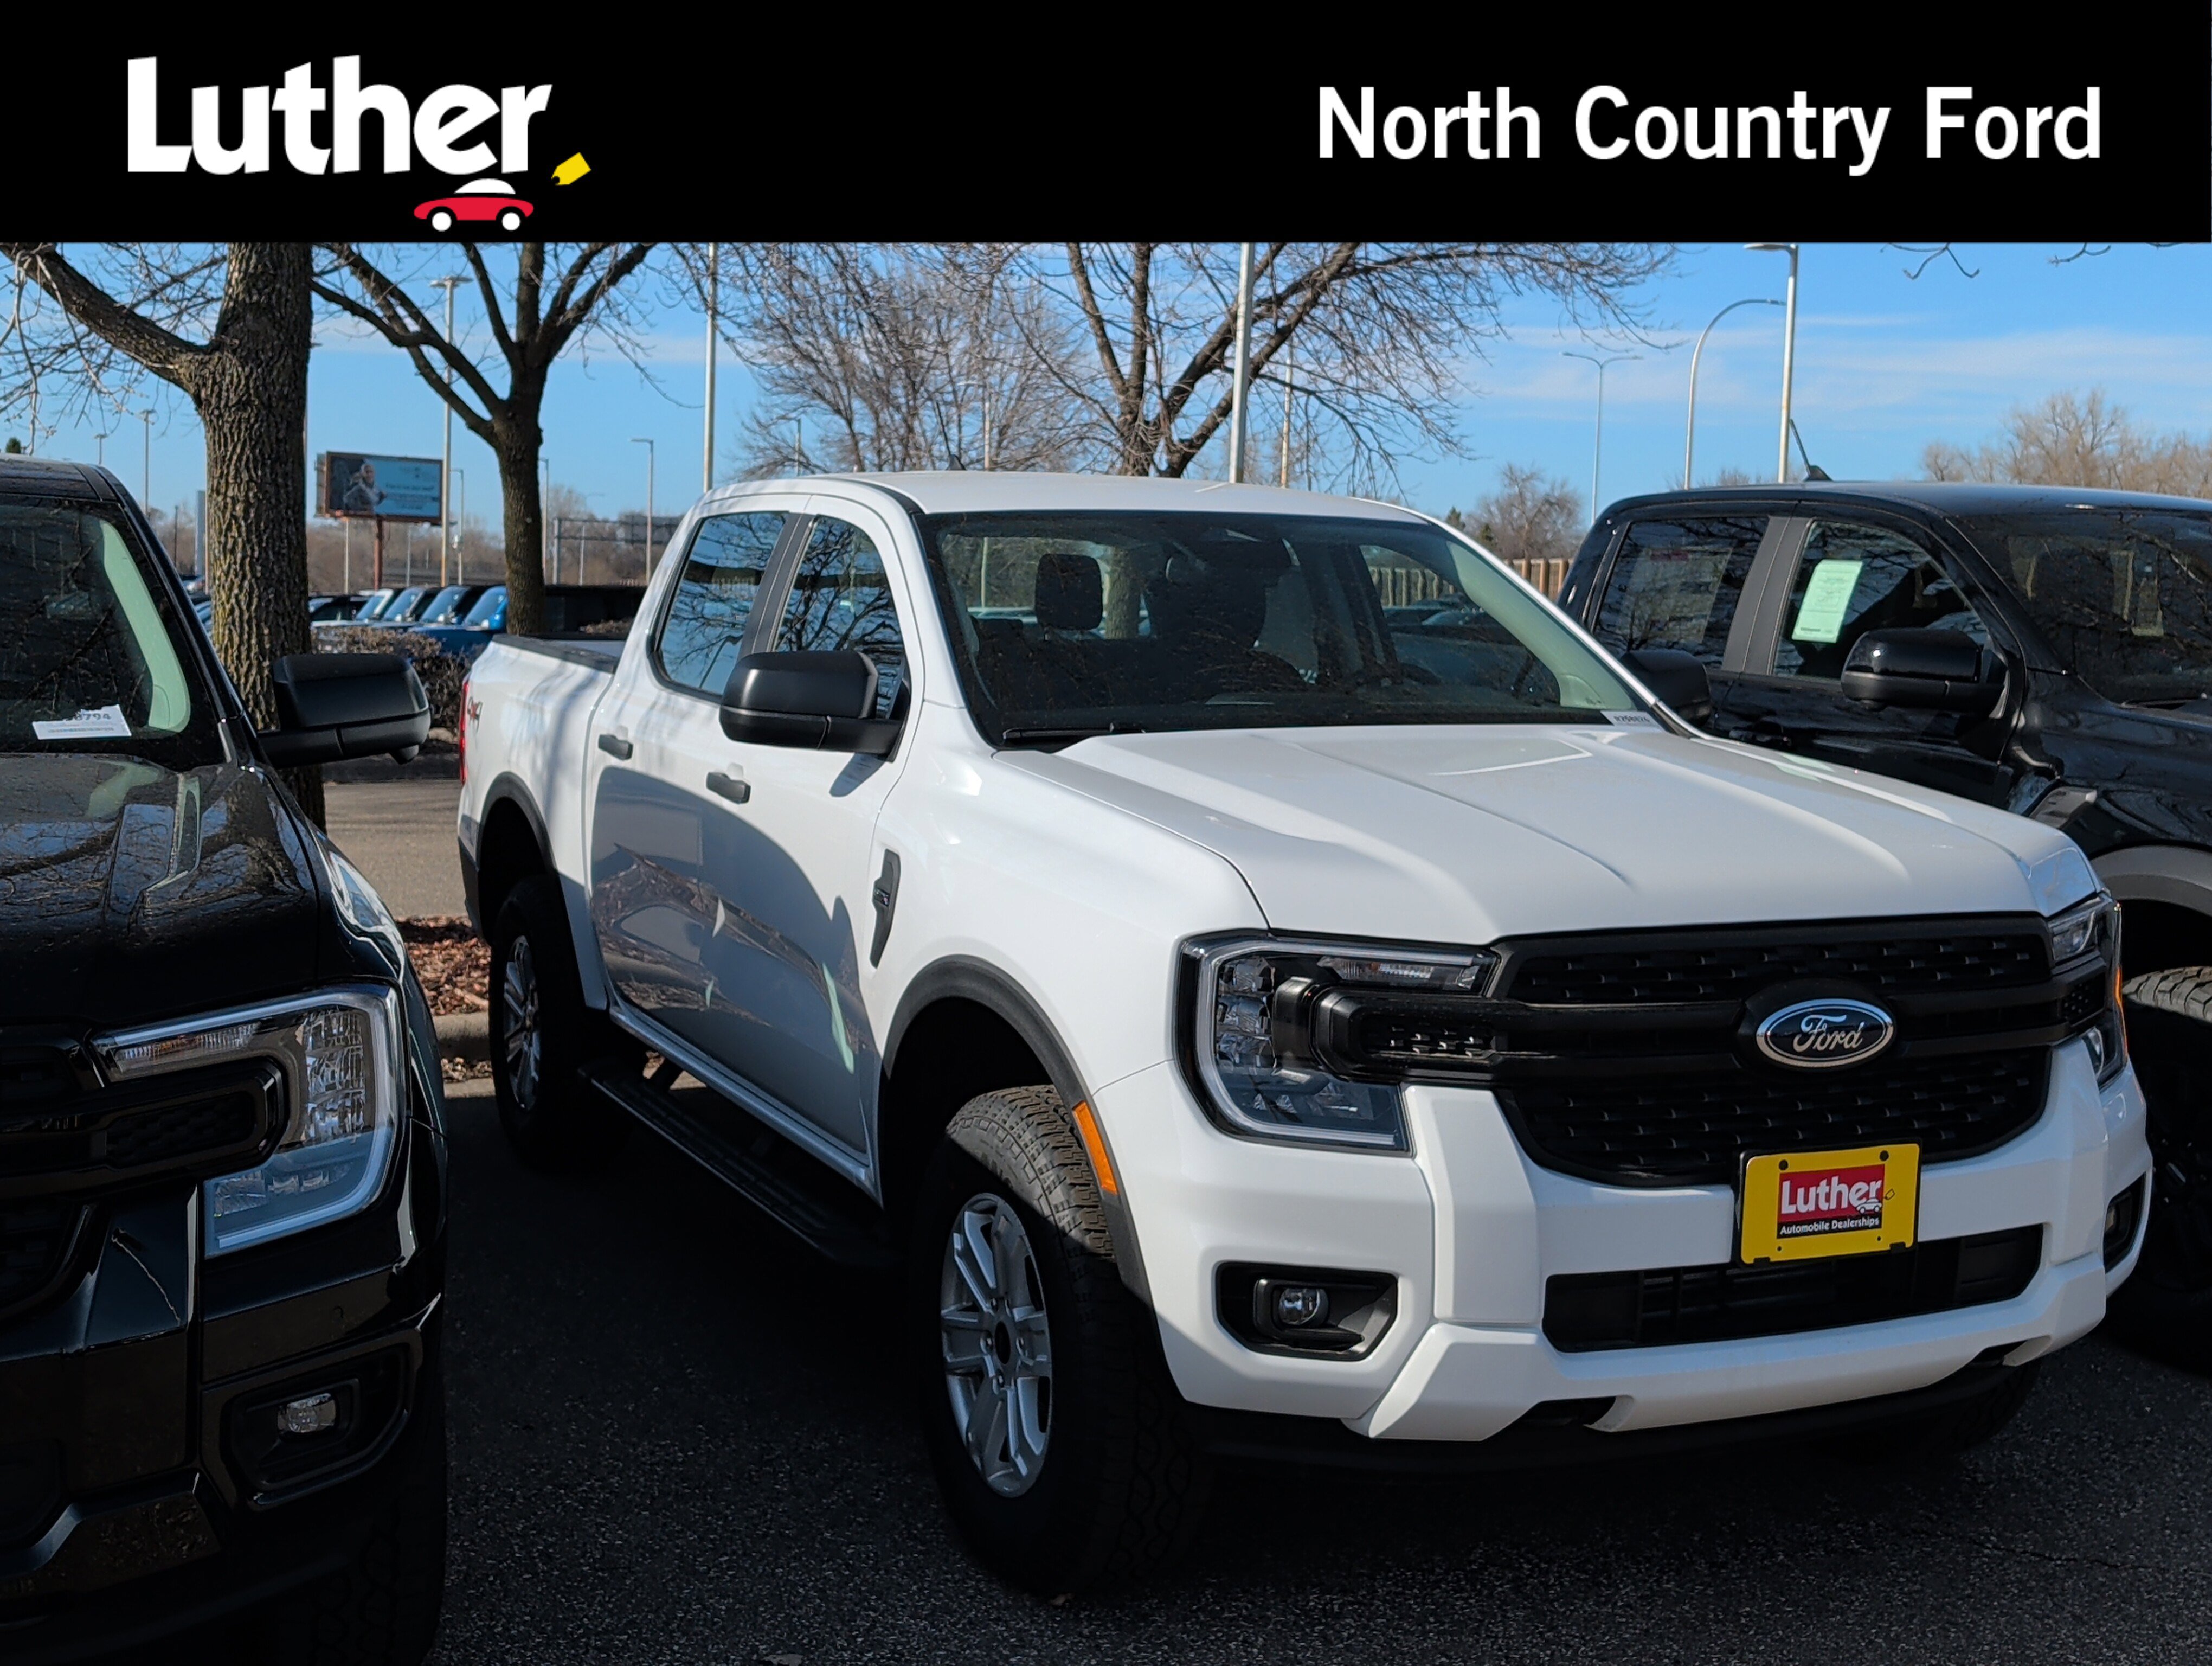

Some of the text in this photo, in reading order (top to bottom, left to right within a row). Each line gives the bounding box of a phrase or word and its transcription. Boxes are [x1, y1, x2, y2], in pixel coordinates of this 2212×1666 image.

[1793, 1014, 1863, 1053] Ford
[1781, 1176, 1883, 1215] Luther
[1779, 1216, 1880, 1235] Automobile Dealerships
